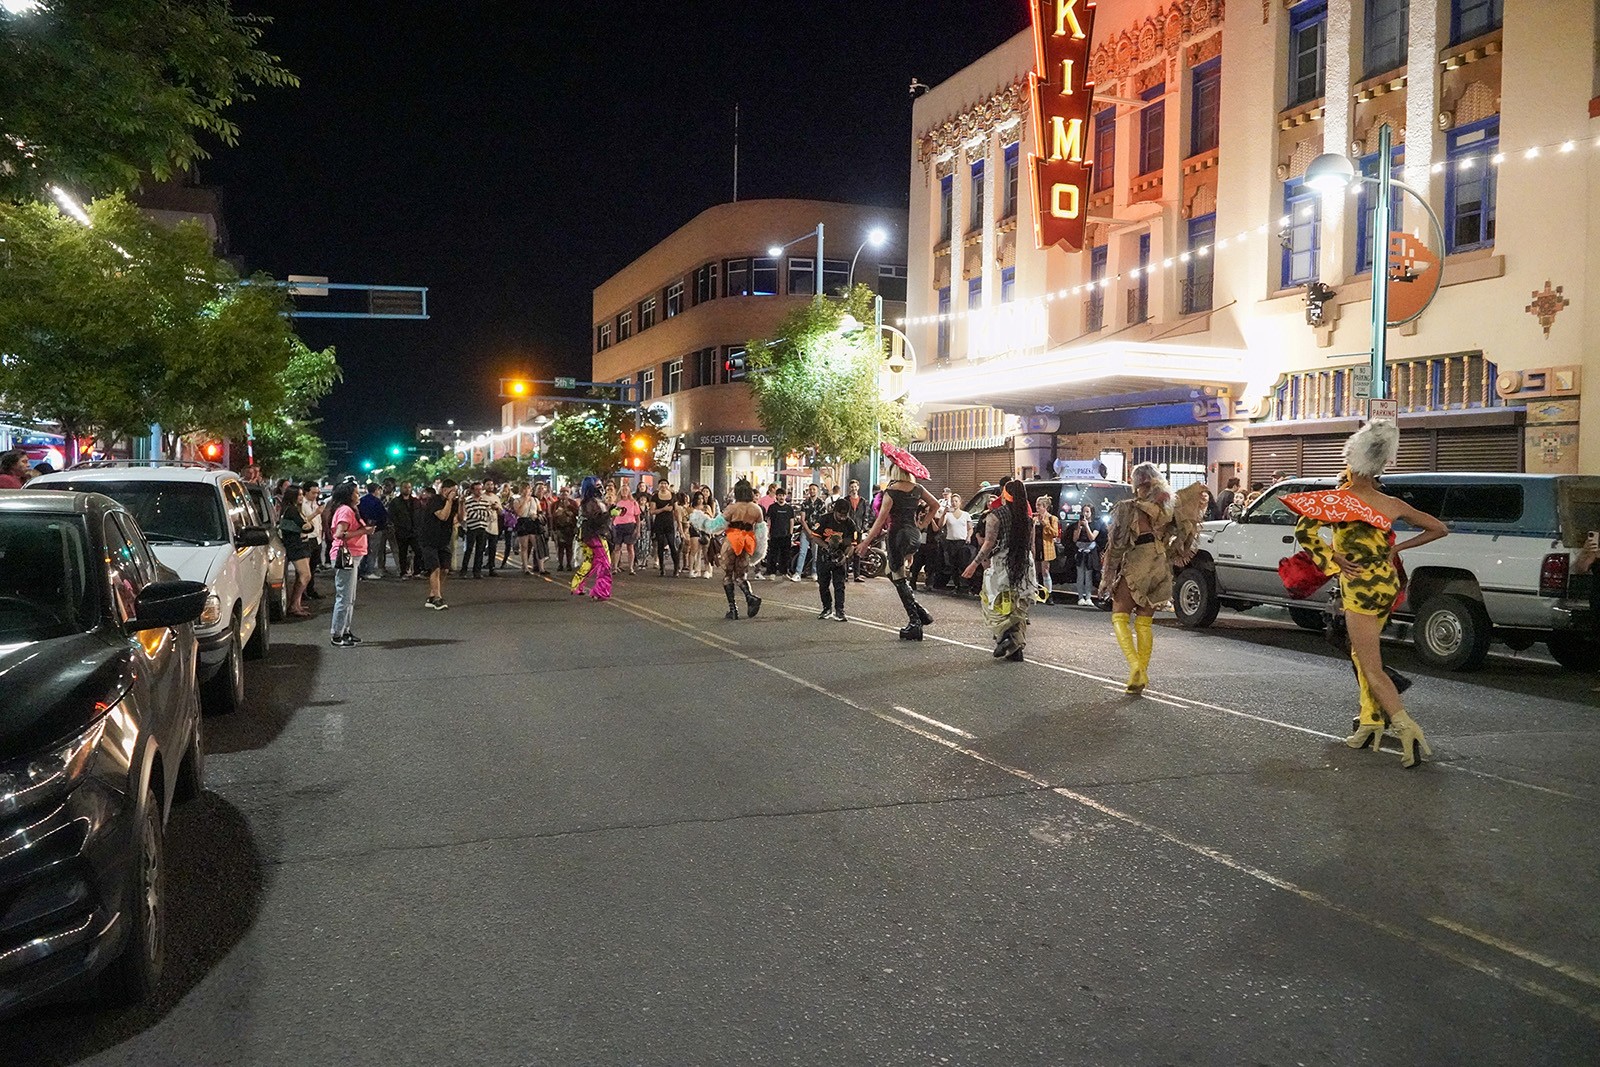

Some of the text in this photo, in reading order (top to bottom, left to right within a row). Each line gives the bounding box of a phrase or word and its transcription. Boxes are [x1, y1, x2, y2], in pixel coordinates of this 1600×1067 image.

[1051, 0, 1086, 219] KIMO
[1372, 409, 1395, 417] PARKING
[710, 434, 749, 444] CENTRAL
